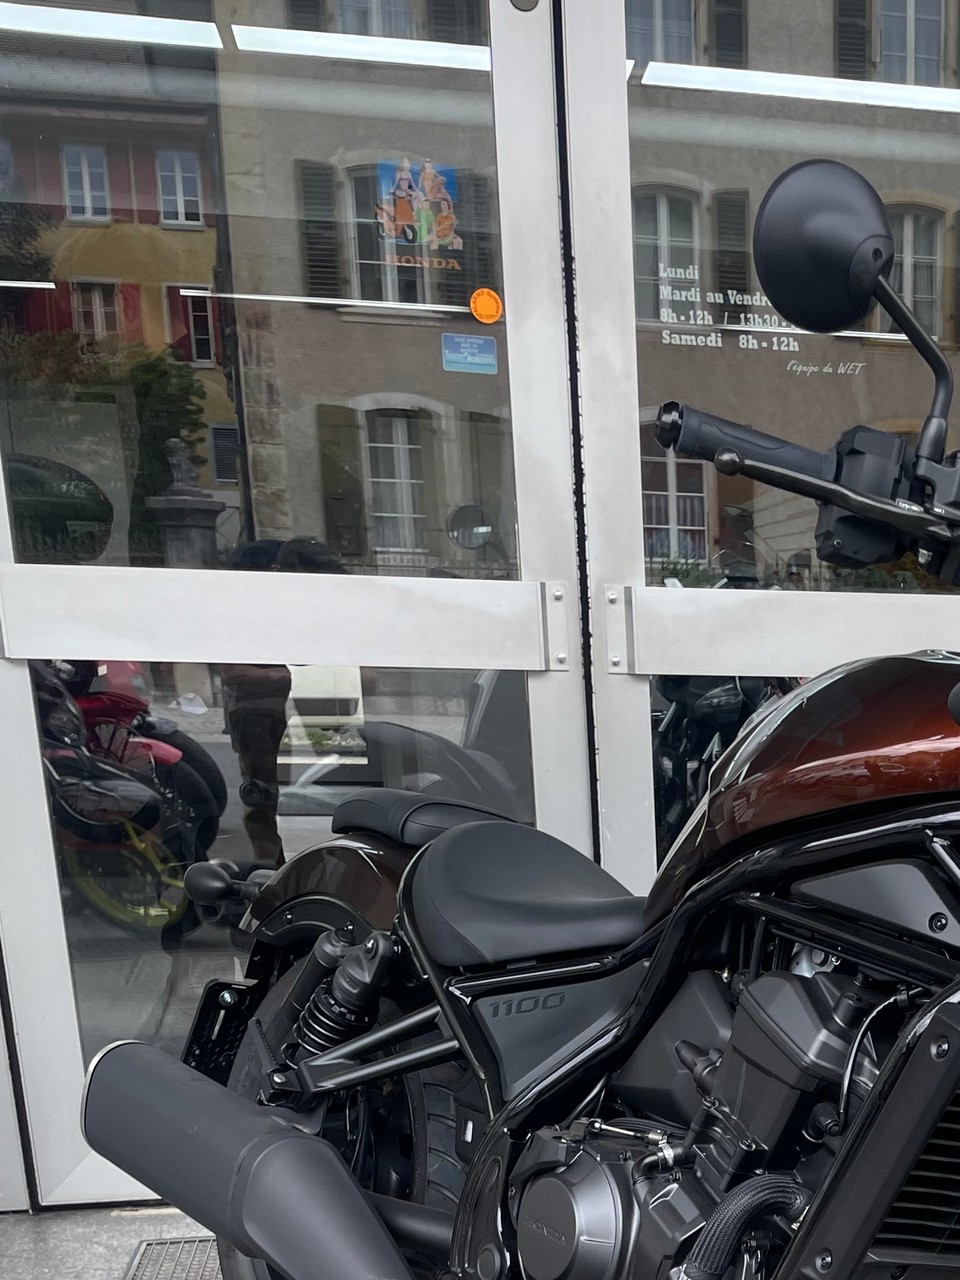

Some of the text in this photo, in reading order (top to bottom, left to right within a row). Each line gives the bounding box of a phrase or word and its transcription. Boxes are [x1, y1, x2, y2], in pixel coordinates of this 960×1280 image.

[385, 254, 462, 271] HONDA
[659, 263, 699, 280] Lundi
[659, 285, 774, 307] Mardi au Vendr
[660, 309, 678, 324] 8h
[689, 310, 713, 325] 12h
[739, 313, 779, 329] 13h30
[662, 330, 723, 348] Samedi
[739, 336, 759, 350] 8h
[771, 337, 799, 352] 12h
[822, 364, 833, 374] du
[837, 362, 867, 375] WET
[488, 991, 567, 1019] 1100
